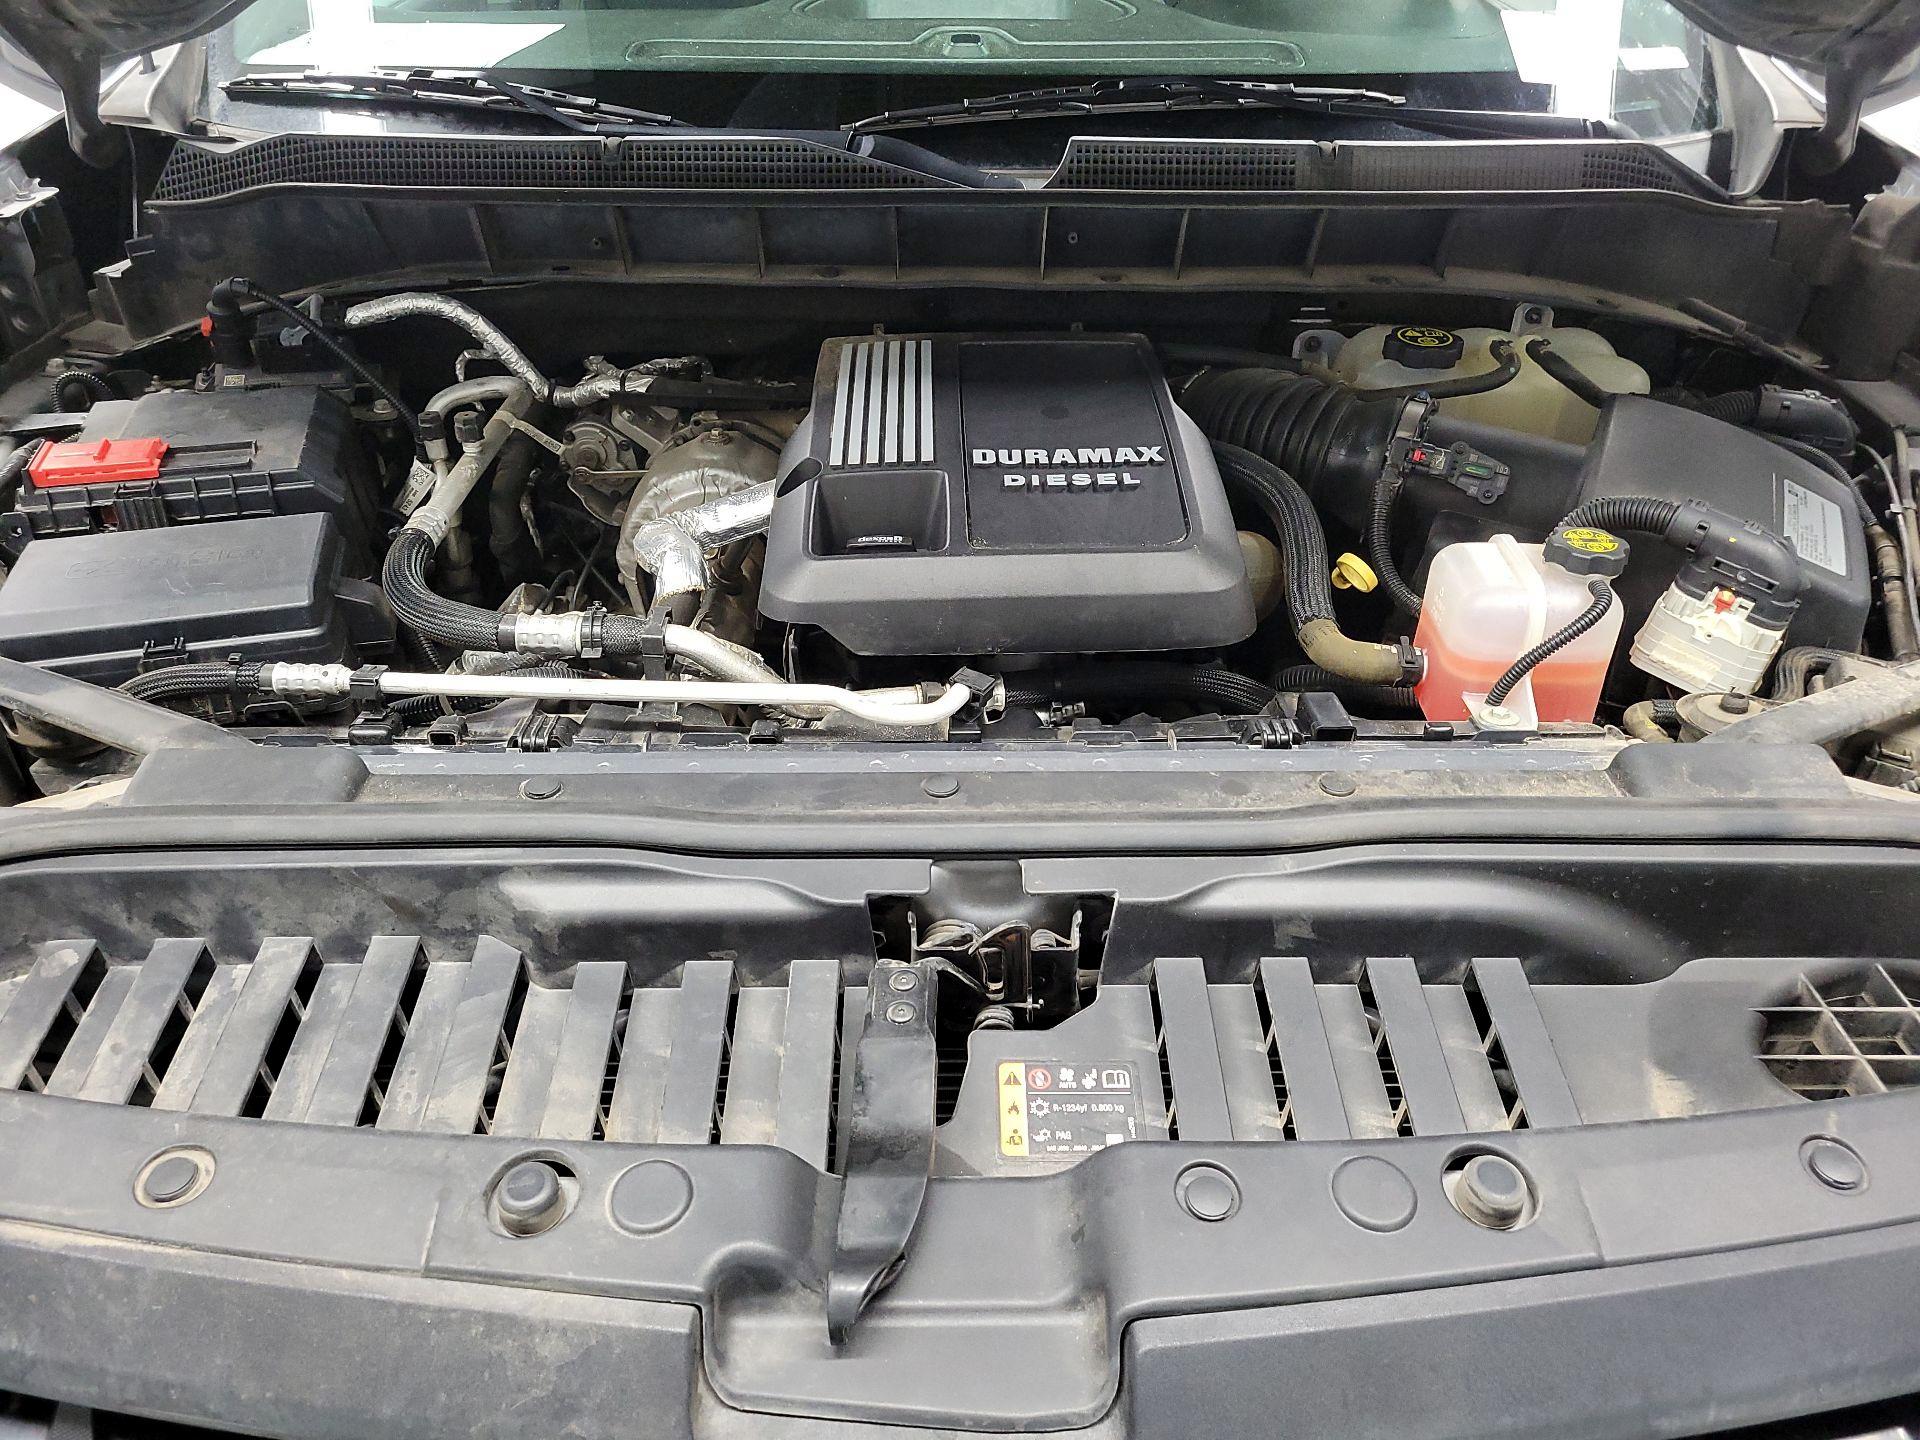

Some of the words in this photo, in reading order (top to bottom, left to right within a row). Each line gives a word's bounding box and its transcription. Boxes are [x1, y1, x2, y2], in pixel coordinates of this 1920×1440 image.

[972, 446, 1165, 465] DURAMAX
[1003, 472, 1141, 487] DIESEL
[1114, 1104, 1125, 1114] kg
[1055, 1130, 1072, 1140] PAG
